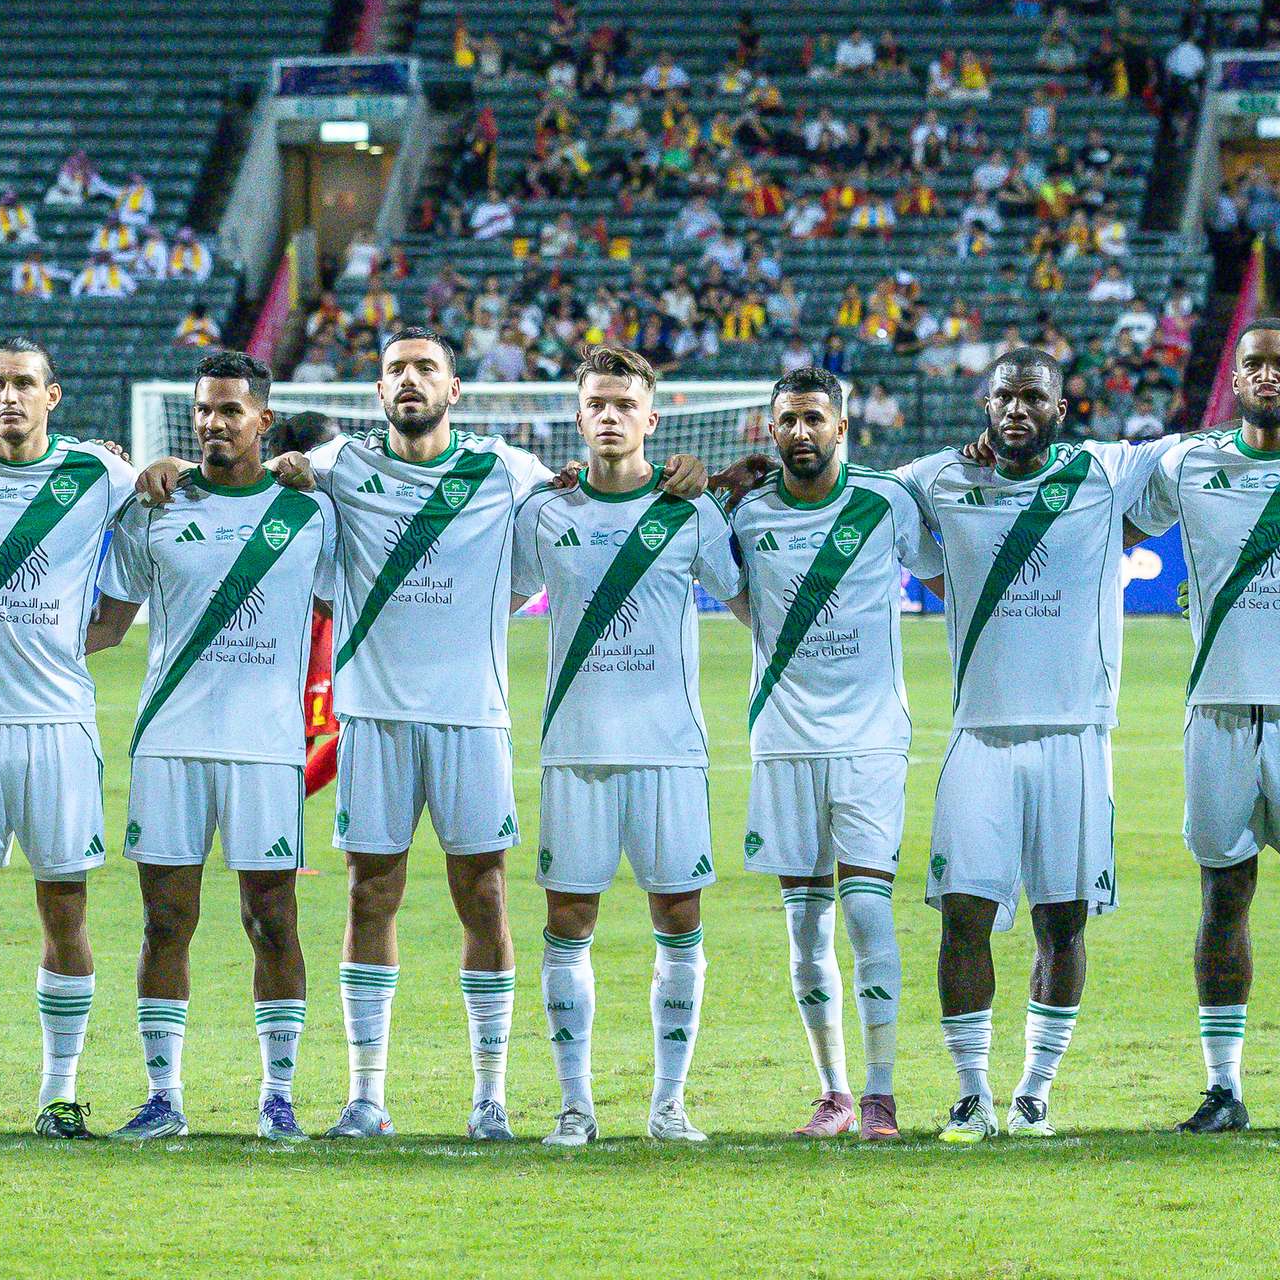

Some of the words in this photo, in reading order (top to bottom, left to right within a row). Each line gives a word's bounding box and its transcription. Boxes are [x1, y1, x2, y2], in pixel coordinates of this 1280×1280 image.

[391, 592, 411, 602] Sea
[414, 593, 452, 604] Global
[1248, 599, 1269, 609] Sea
[1002, 606, 1021, 617] Sea
[1024, 605, 1061, 617] Global
[0, 612, 19, 623] Sea
[22, 613, 59, 625] Global
[797, 648, 818, 658] Sea
[821, 644, 859, 657] Global
[215, 651, 236, 662] Sea
[238, 653, 275, 665] Global
[592, 662, 613, 672] Sea
[616, 660, 655, 672] Global
[548, 1001, 574, 1011] AHLI
[664, 1000, 693, 1011] AHLI
